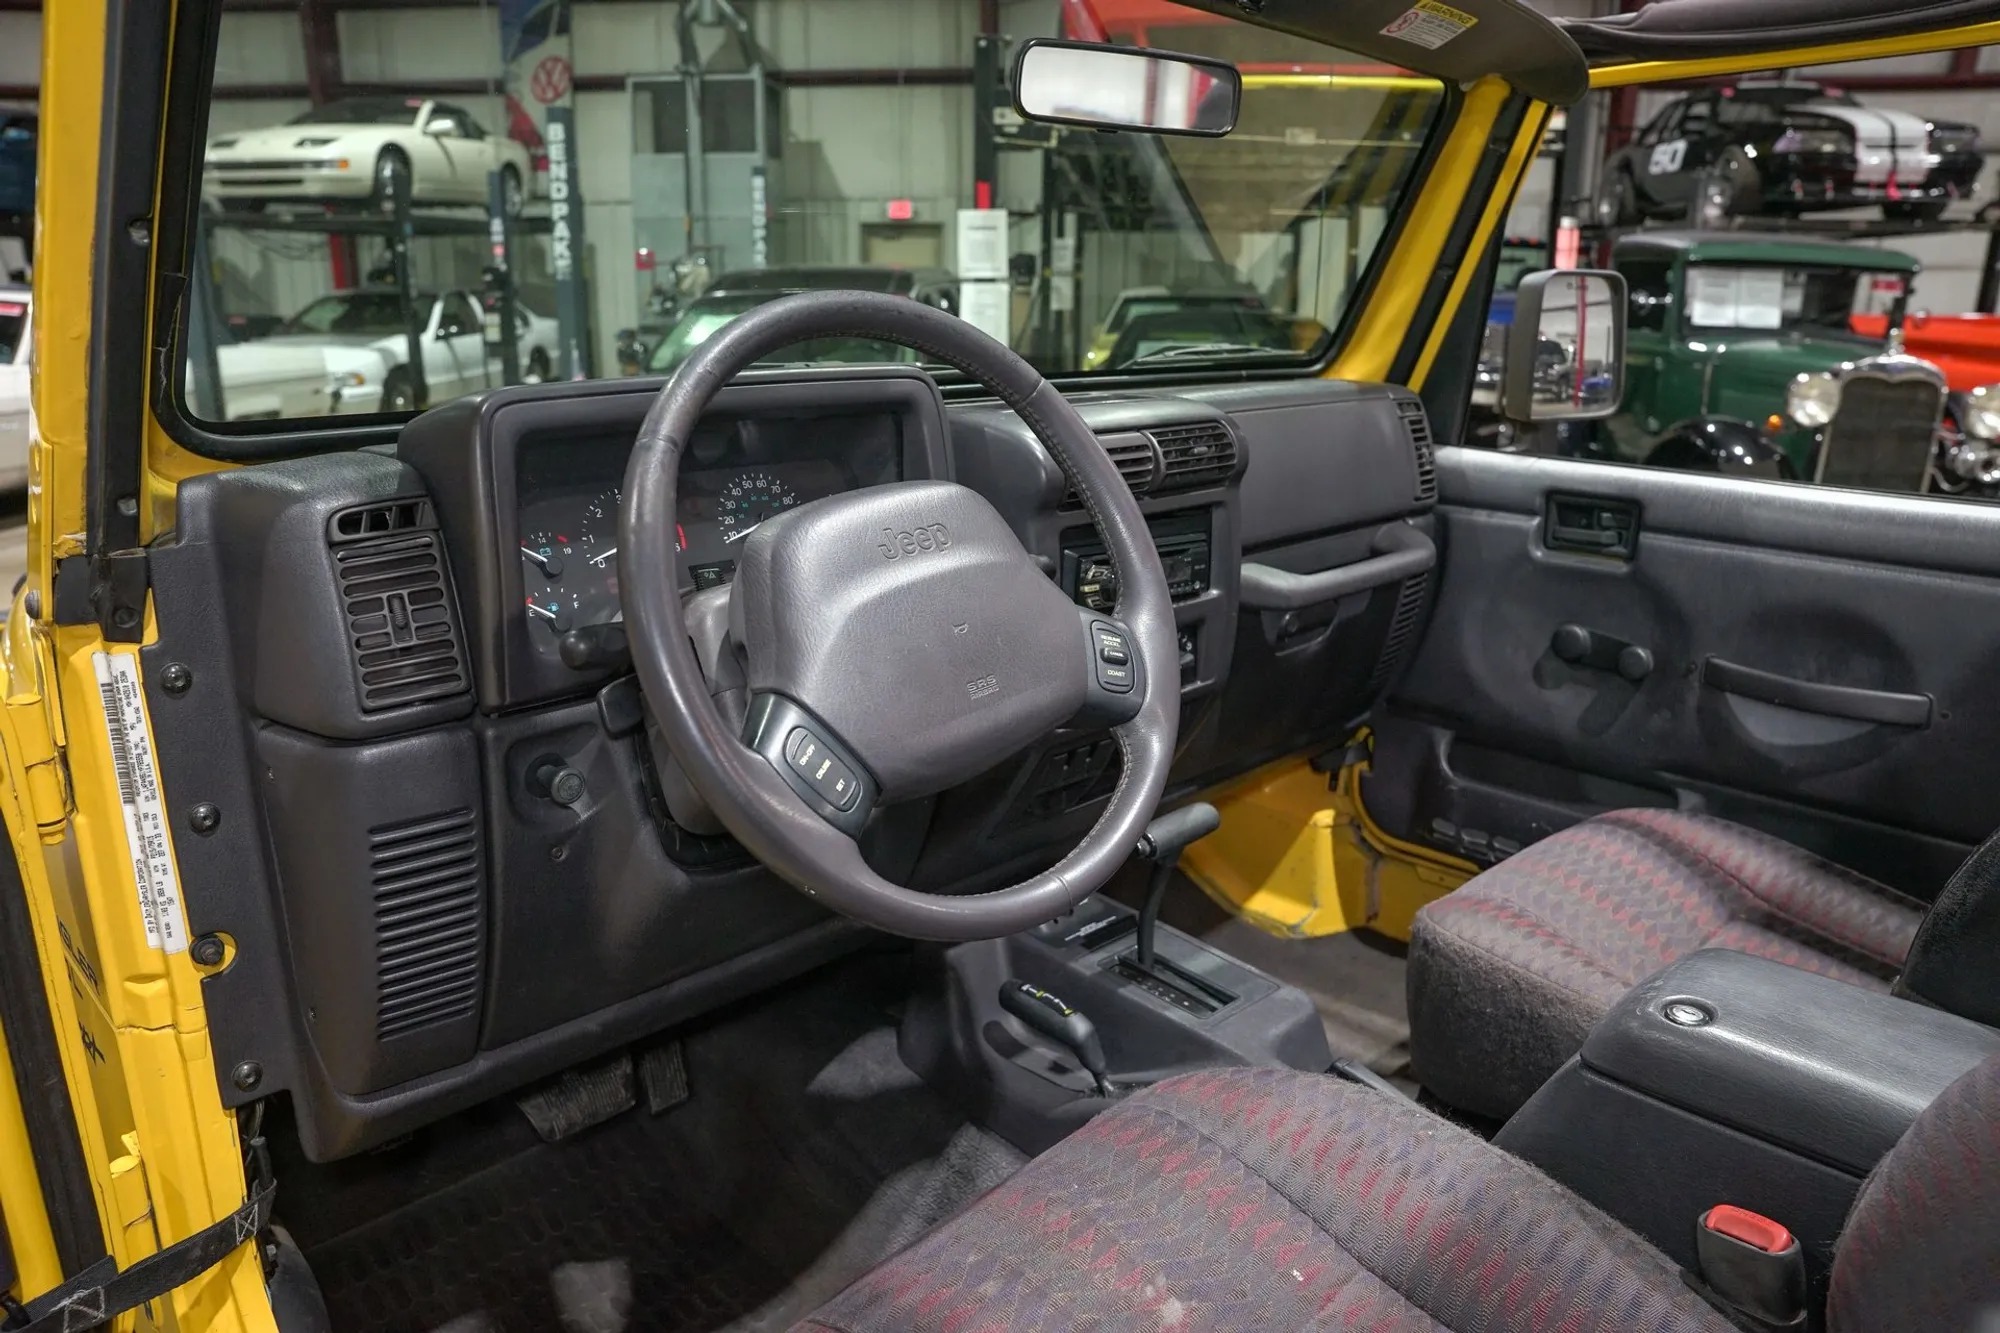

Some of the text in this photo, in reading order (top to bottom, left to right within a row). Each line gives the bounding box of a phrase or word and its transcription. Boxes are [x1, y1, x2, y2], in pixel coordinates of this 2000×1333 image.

[742, 480, 753, 489] 50
[756, 479, 767, 488] 60
[731, 487, 742, 496] 40
[770, 485, 781, 494] 70
[724, 500, 736, 510] 30
[782, 496, 793, 505] 80
[594, 508, 603, 518] 2
[723, 515, 735, 525] 20
[878, 522, 952, 561] Jeep
[563, 547, 572, 555] 19
[597, 558, 606, 568] 0
[573, 601, 580, 609] F
[528, 609, 536, 617] E
[1107, 669, 1126, 678] COAST
[966, 674, 997, 691] SRS
